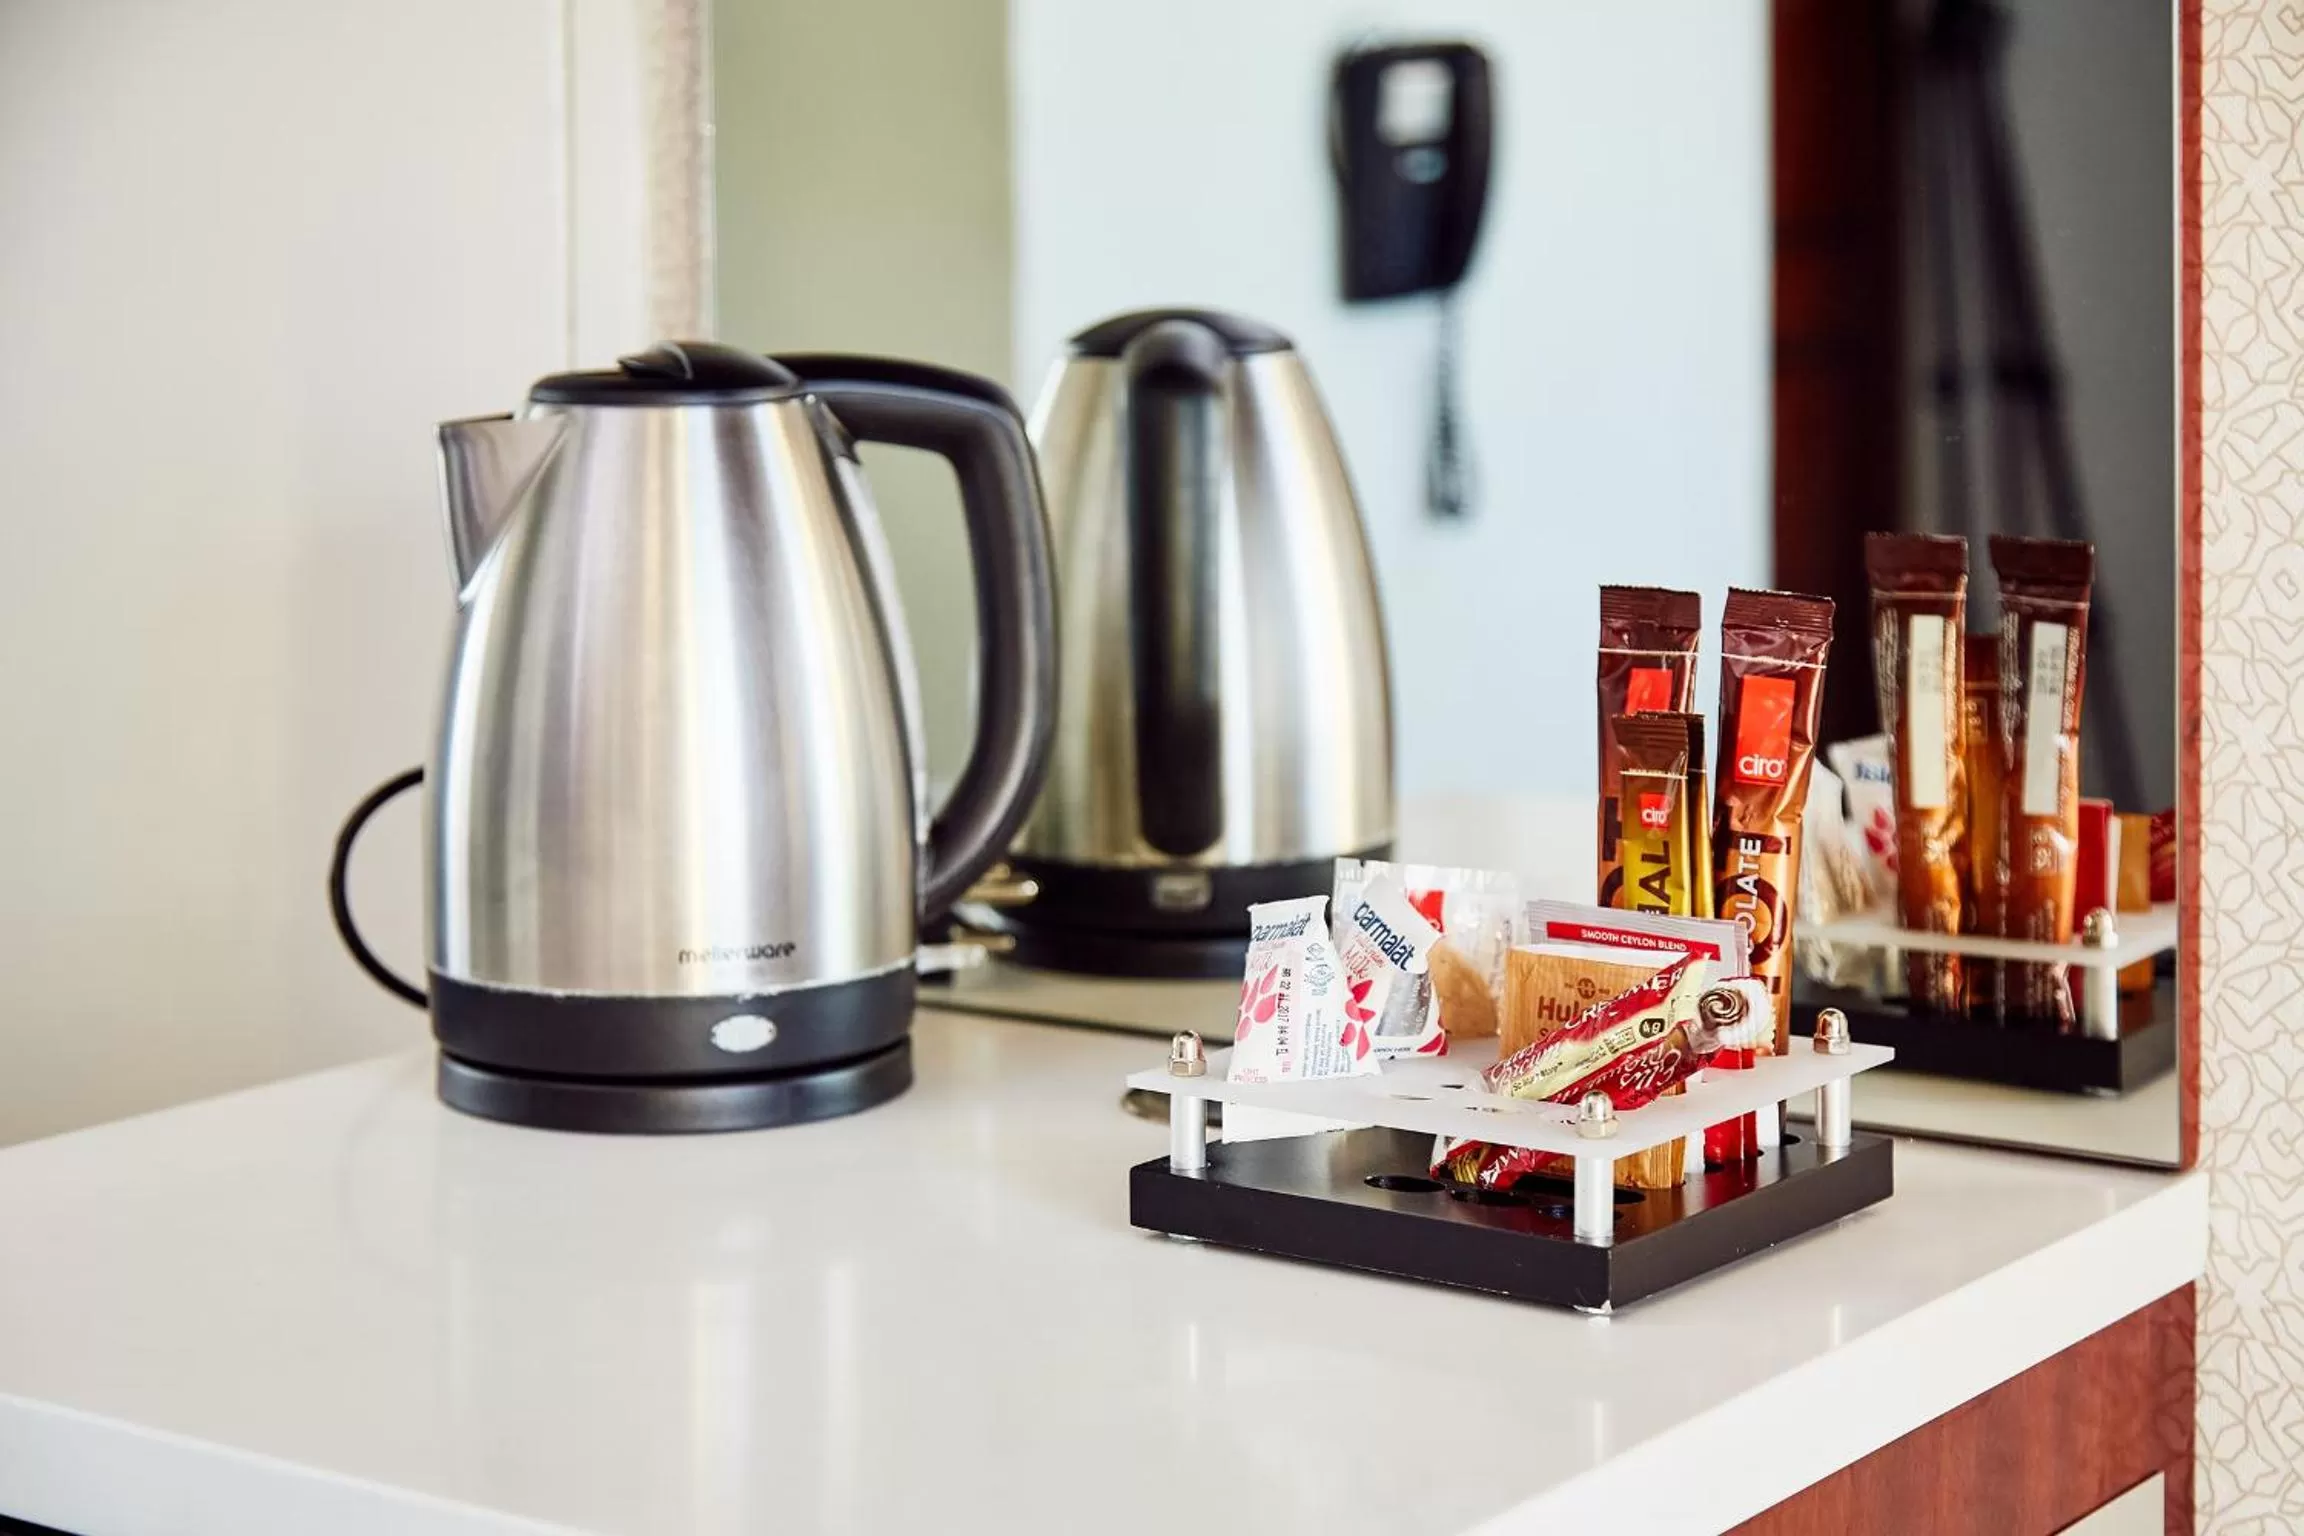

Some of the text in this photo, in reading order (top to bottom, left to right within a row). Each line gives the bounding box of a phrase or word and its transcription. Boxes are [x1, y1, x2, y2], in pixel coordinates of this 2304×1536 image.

[1739, 754, 1784, 778] ciro
[1352, 902, 1415, 971] parmalat
[1580, 929, 1687, 952] SMOOTH CEYLON BLEND
[1537, 995, 1581, 1022] Hul
